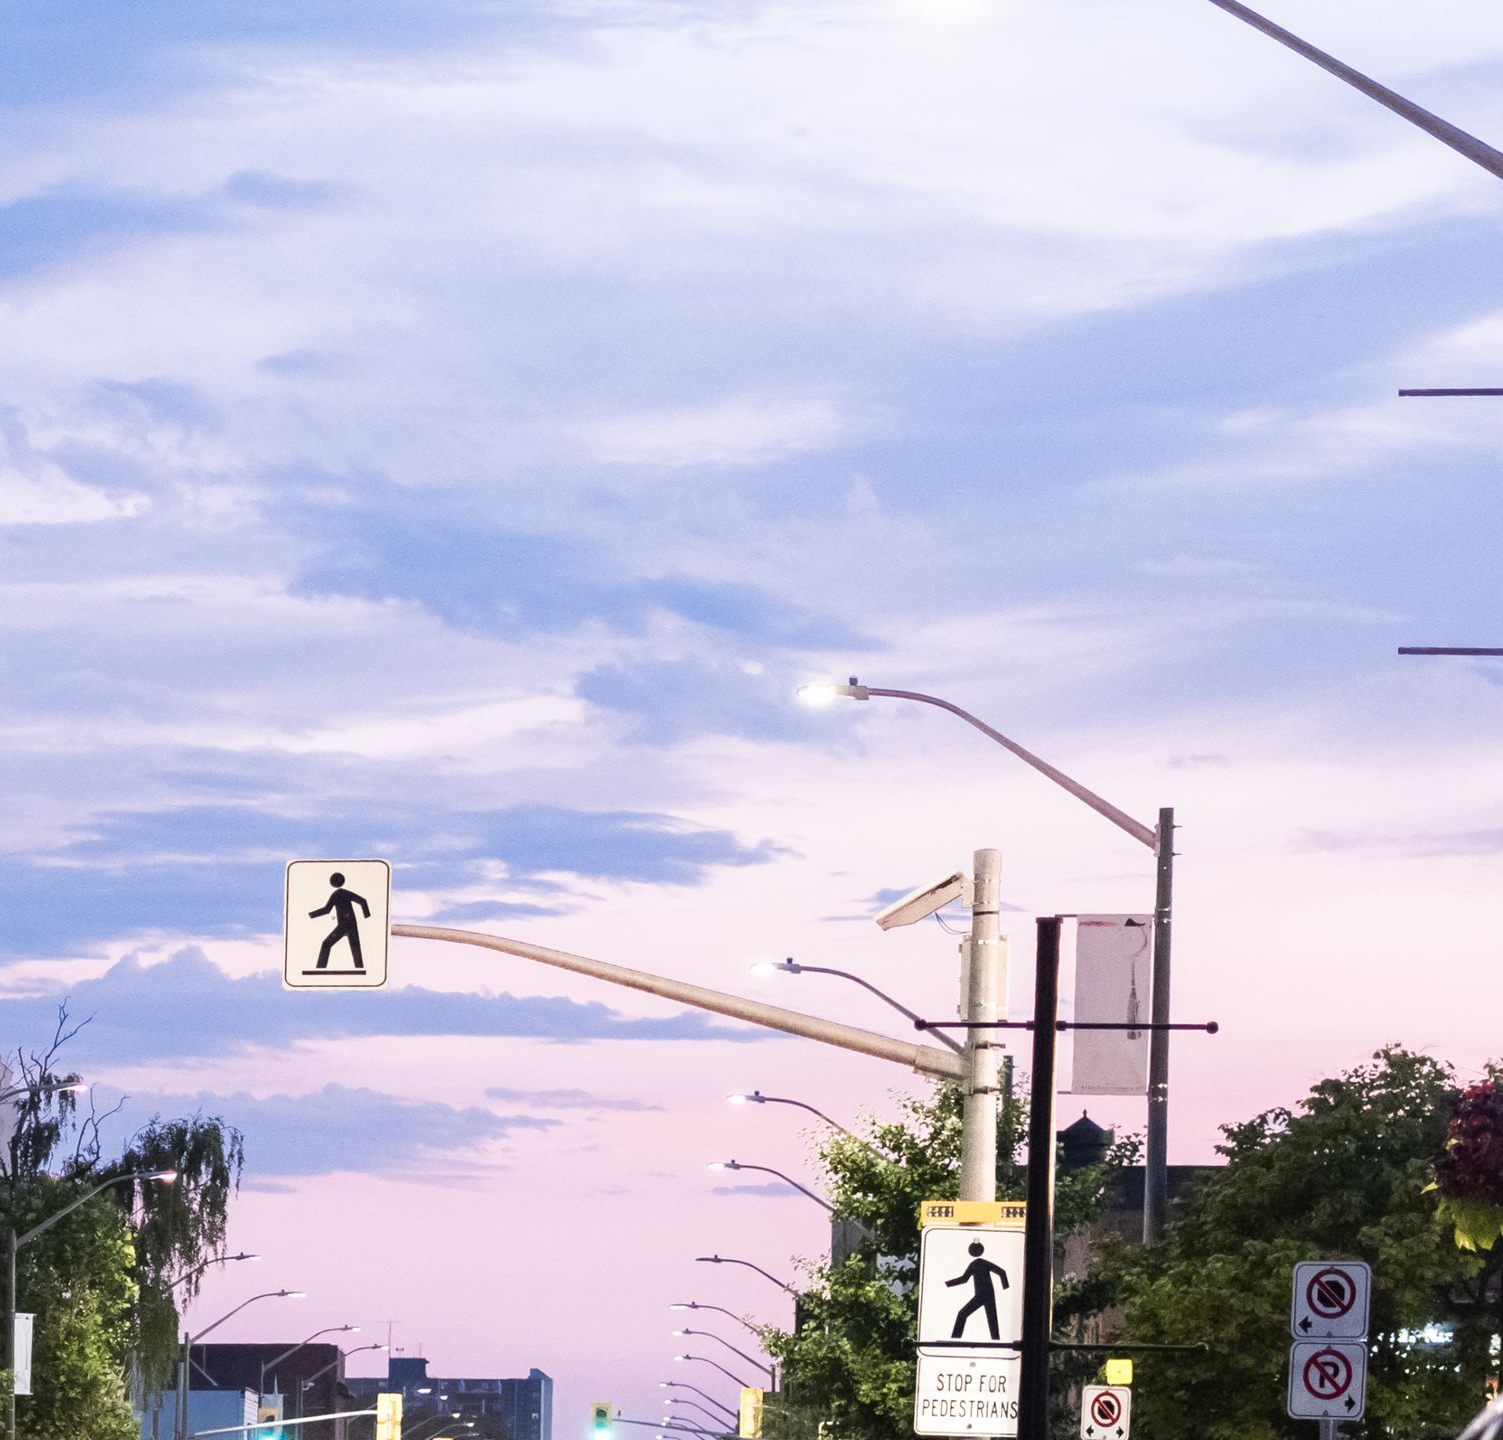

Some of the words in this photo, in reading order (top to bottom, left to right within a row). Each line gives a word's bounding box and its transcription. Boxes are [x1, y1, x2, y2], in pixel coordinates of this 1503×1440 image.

[936, 1373, 973, 1392] STOP
[979, 1374, 1007, 1393] FOR
[922, 1398, 1018, 1419] PEDESTRIANS
